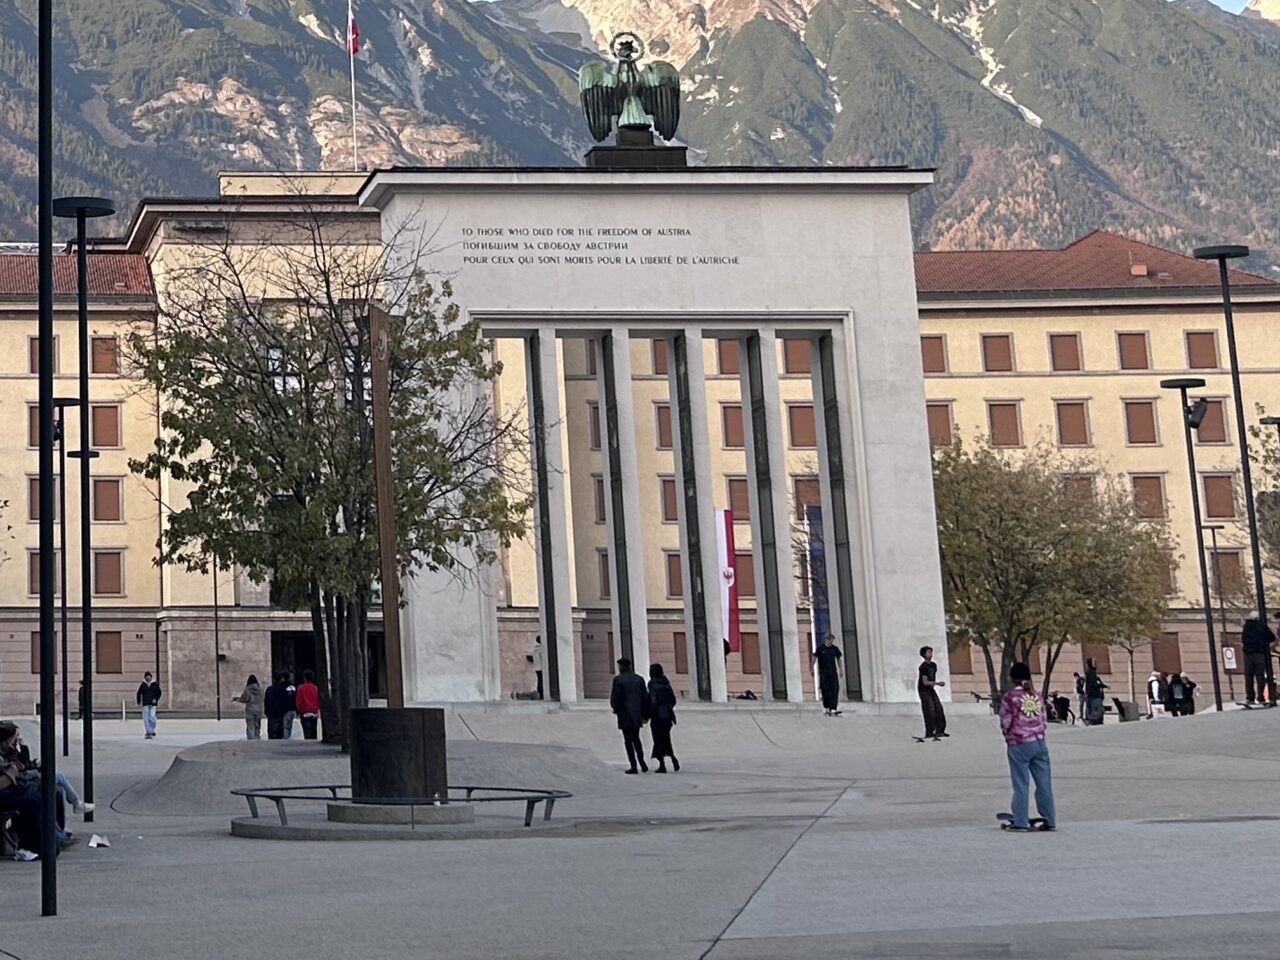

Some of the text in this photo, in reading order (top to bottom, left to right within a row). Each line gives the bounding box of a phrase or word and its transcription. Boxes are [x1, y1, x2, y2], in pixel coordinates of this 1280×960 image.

[462, 228, 692, 236] TO THOSE WHO DIED FOR THE FREEDOM OF AUSTRIA
[463, 242, 628, 252] ПОГИБШИМ ЗА СВОБОДУ АВСТРИИ
[464, 254, 740, 266] POUR CEUX QUI SONT MORTS POUR LA LIBERTÉ DE L'AUTRICHE
